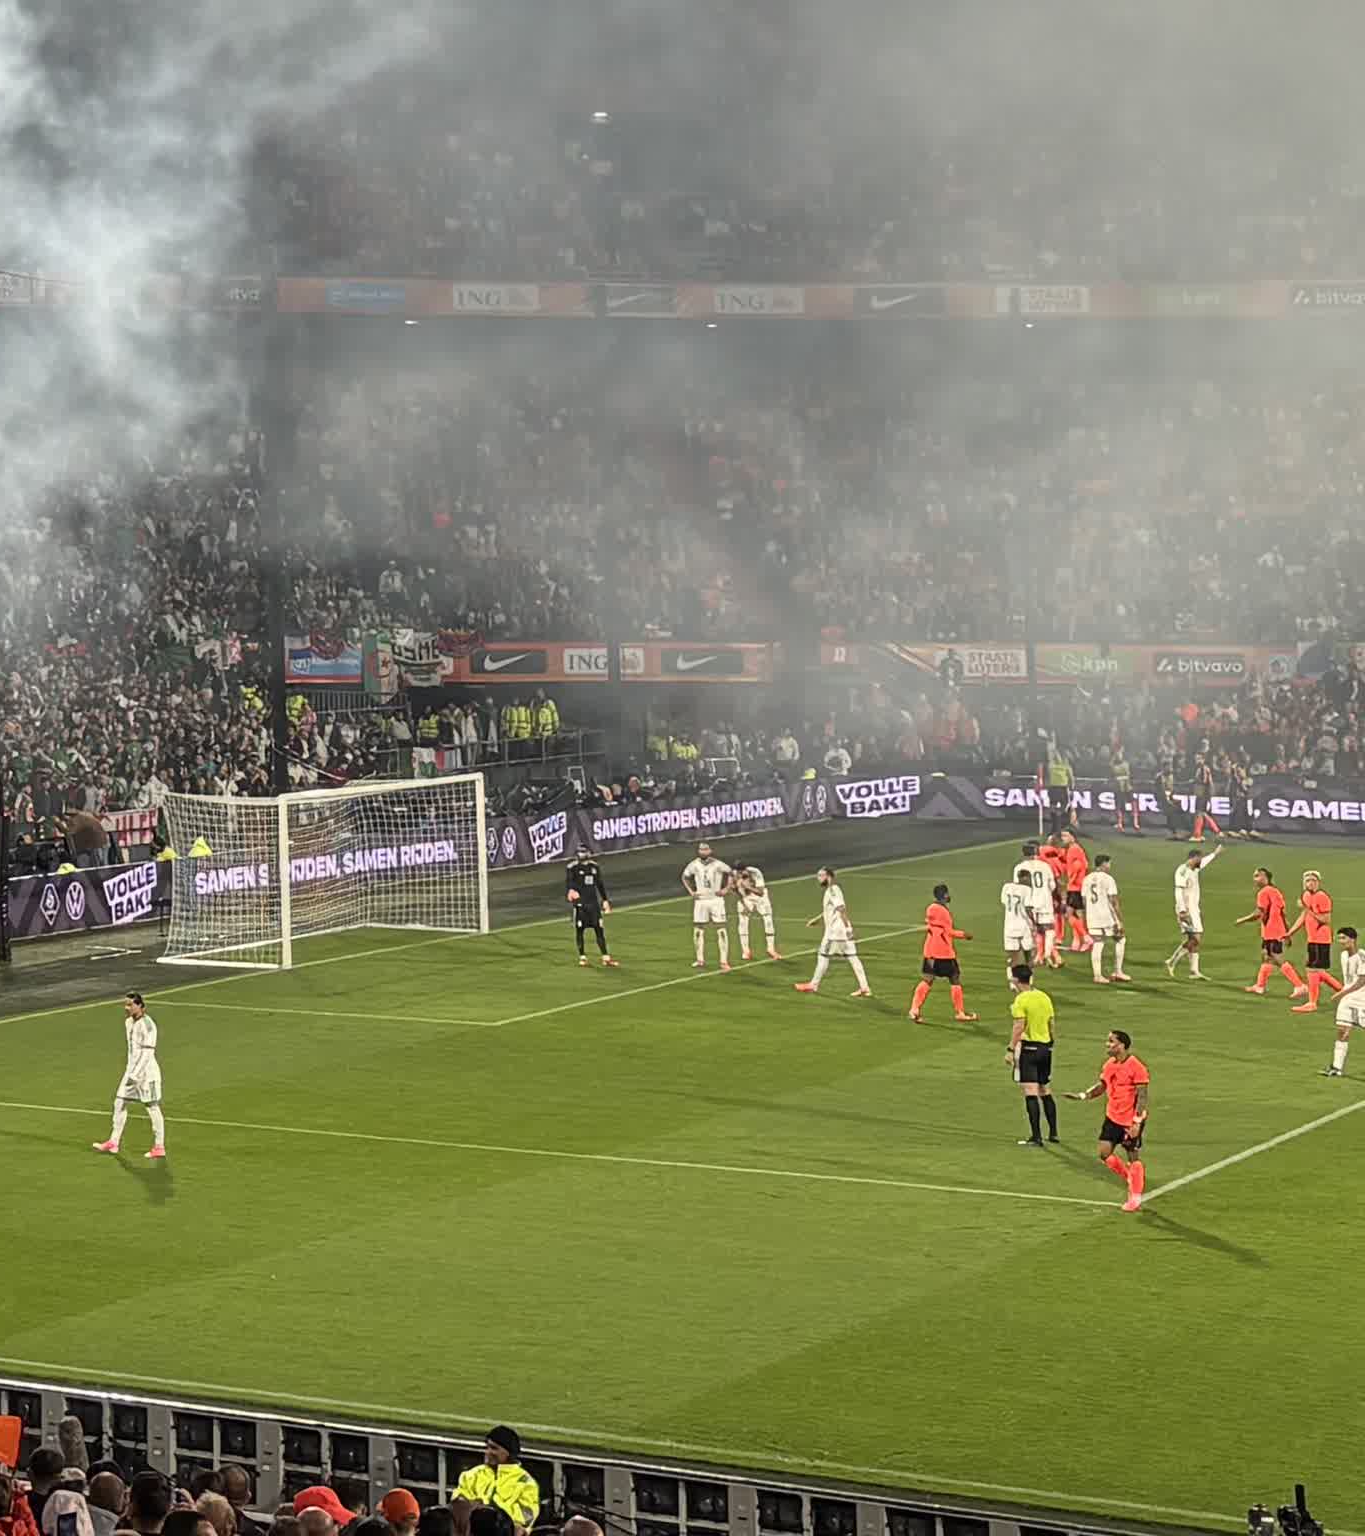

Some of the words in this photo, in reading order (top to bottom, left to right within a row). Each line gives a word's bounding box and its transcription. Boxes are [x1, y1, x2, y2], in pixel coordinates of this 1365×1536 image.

[569, 653, 608, 672] ING
[1178, 658, 1243, 672] bitvavo
[839, 777, 918, 802] VOLLE
[984, 788, 1092, 809] SAMN
[849, 794, 908, 815] BAK!
[593, 817, 637, 841] SAMEN
[701, 803, 742, 826] SAMEN
[195, 864, 257, 895] SAMEN
[342, 846, 400, 875] SAMEN
[401, 839, 459, 866] RIJDEN.
[106, 866, 156, 901] VOLLE
[114, 888, 152, 921] BAK!
[1006, 893, 1021, 915] 17
